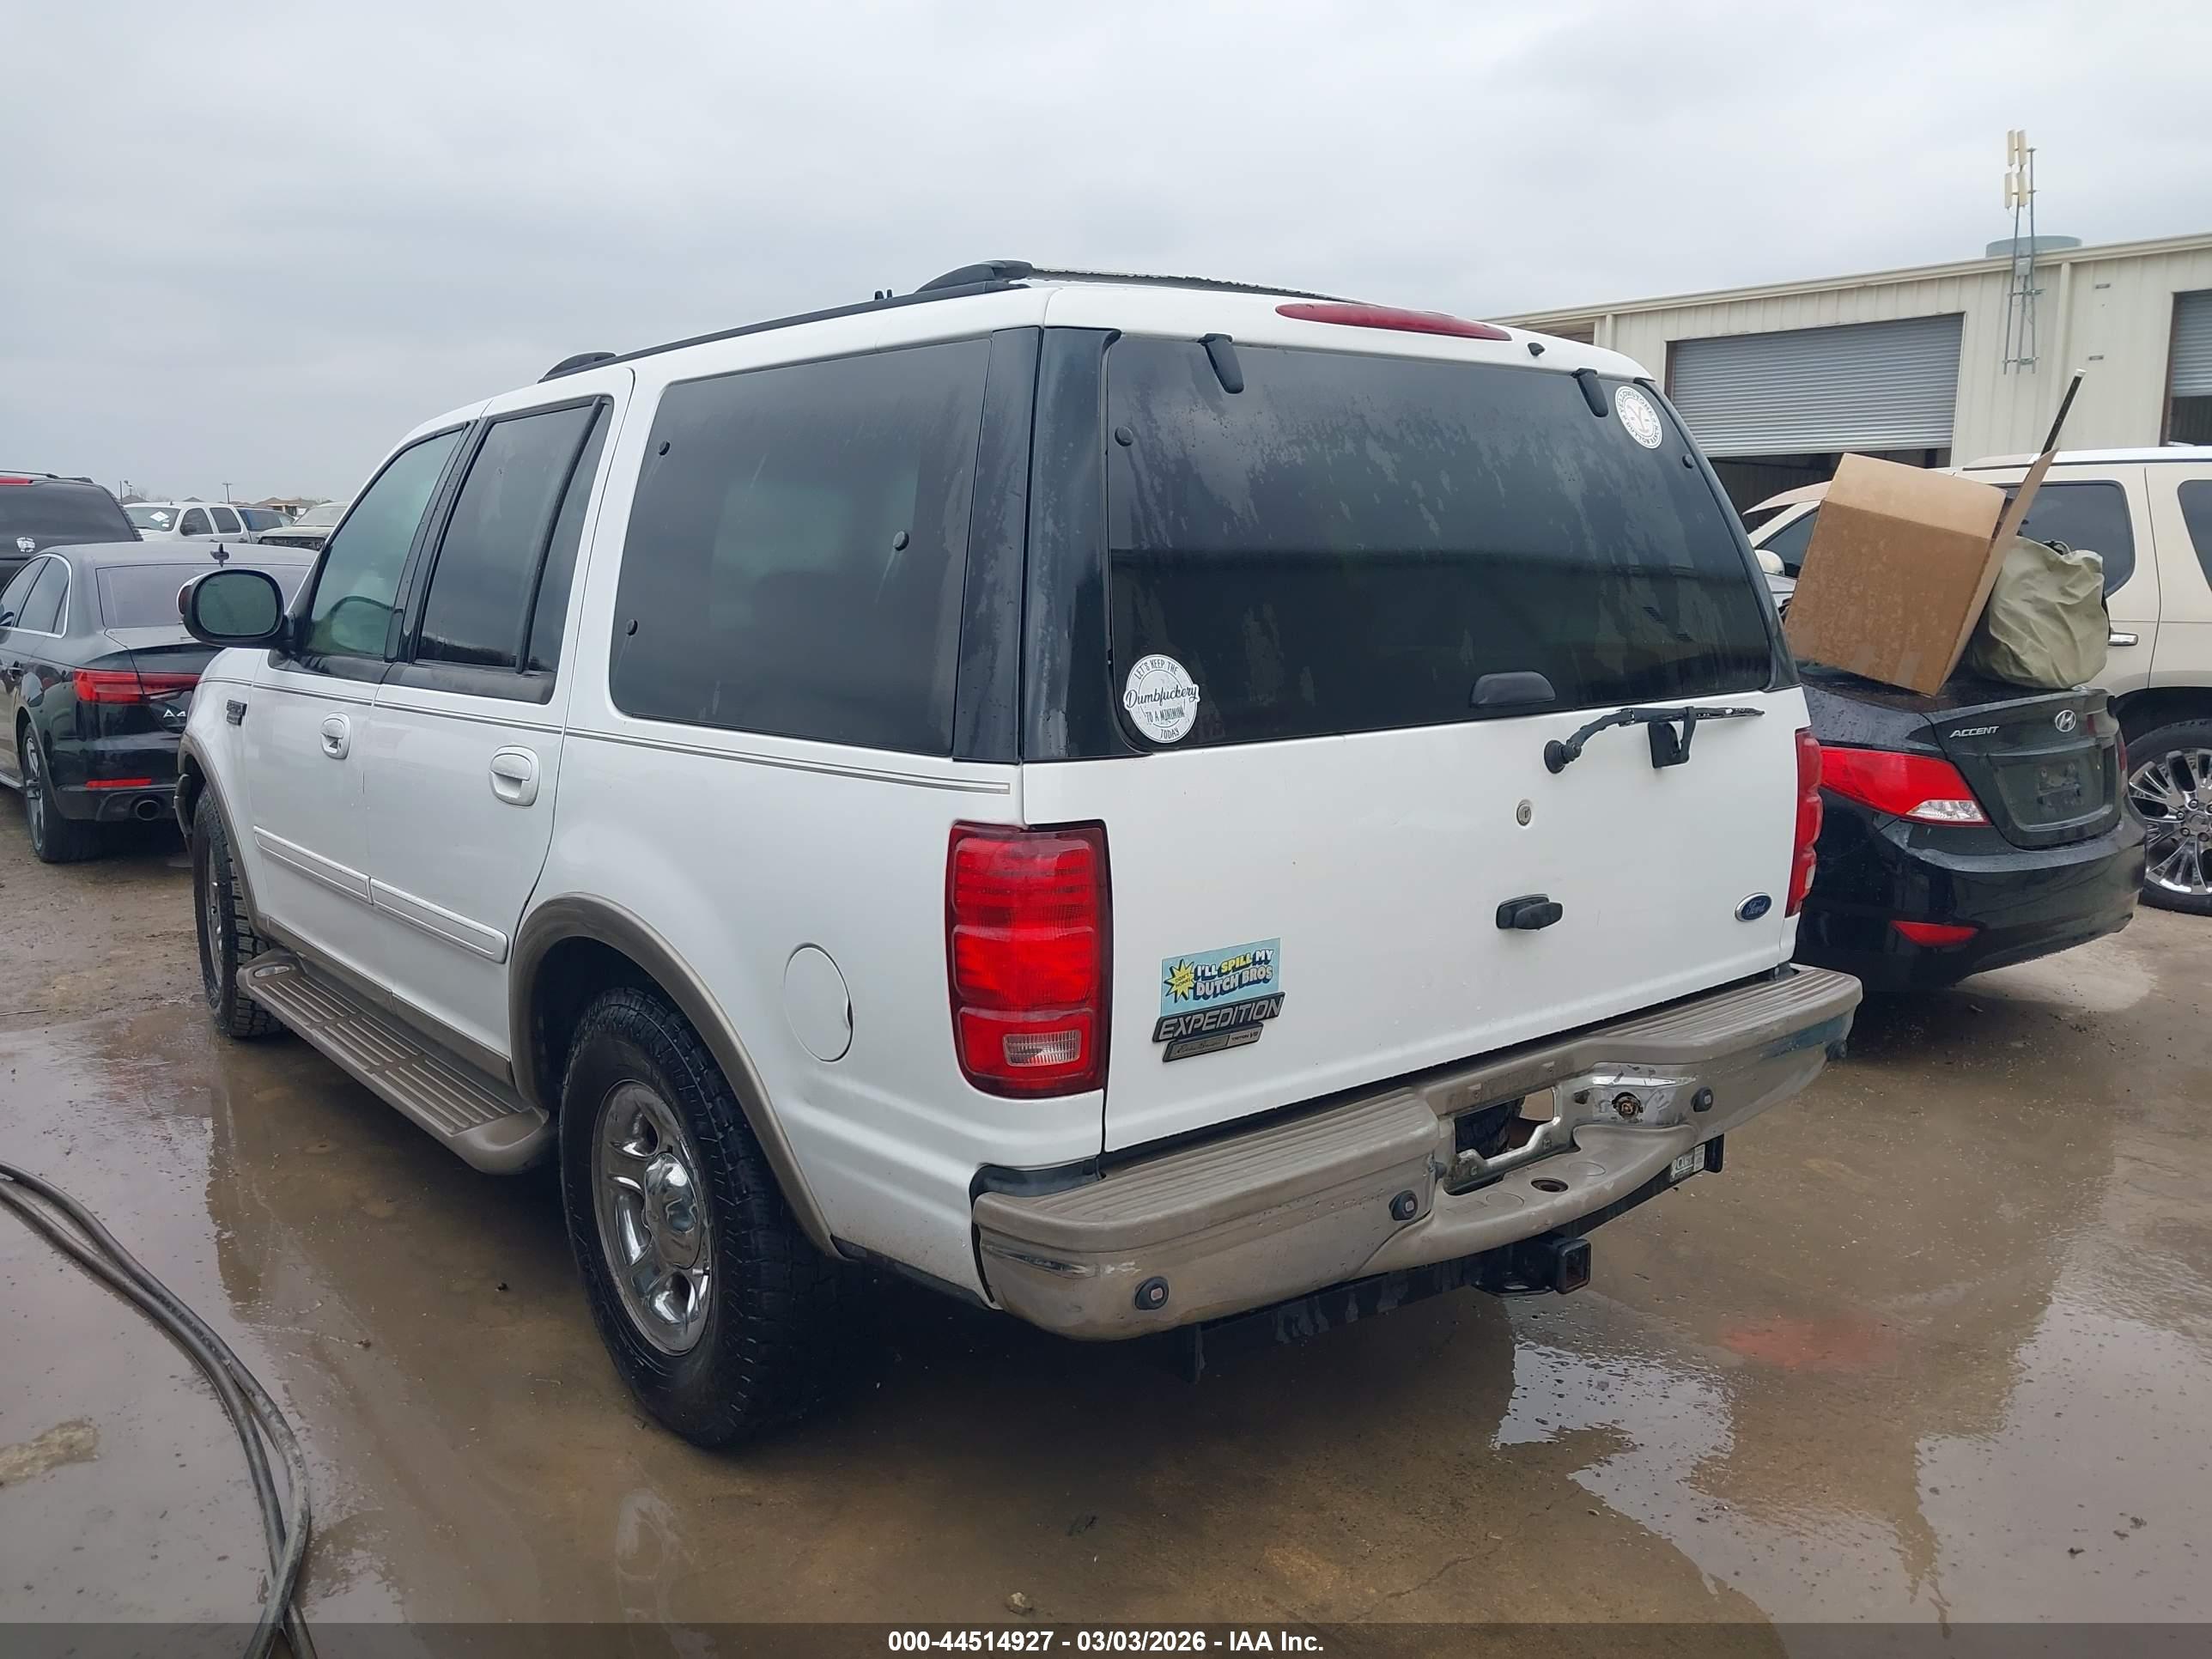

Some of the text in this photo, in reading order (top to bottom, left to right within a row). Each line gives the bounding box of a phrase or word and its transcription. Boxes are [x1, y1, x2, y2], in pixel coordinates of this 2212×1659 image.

[1133, 659, 1179, 680] LET'S KEEP THE
[1125, 684, 1199, 708] Dumbfuckery
[162, 708, 186, 719] A4
[1146, 711, 1154, 723] TO
[1155, 711, 1160, 722] A
[1160, 727, 1181, 739] TODAY
[1948, 726, 2000, 738] ACCENT
[1195, 949, 1274, 979] I'LL SPILL MY
[1194, 964, 1273, 998] DUTCH BROS
[1159, 996, 1284, 1040] EXPEDITION
